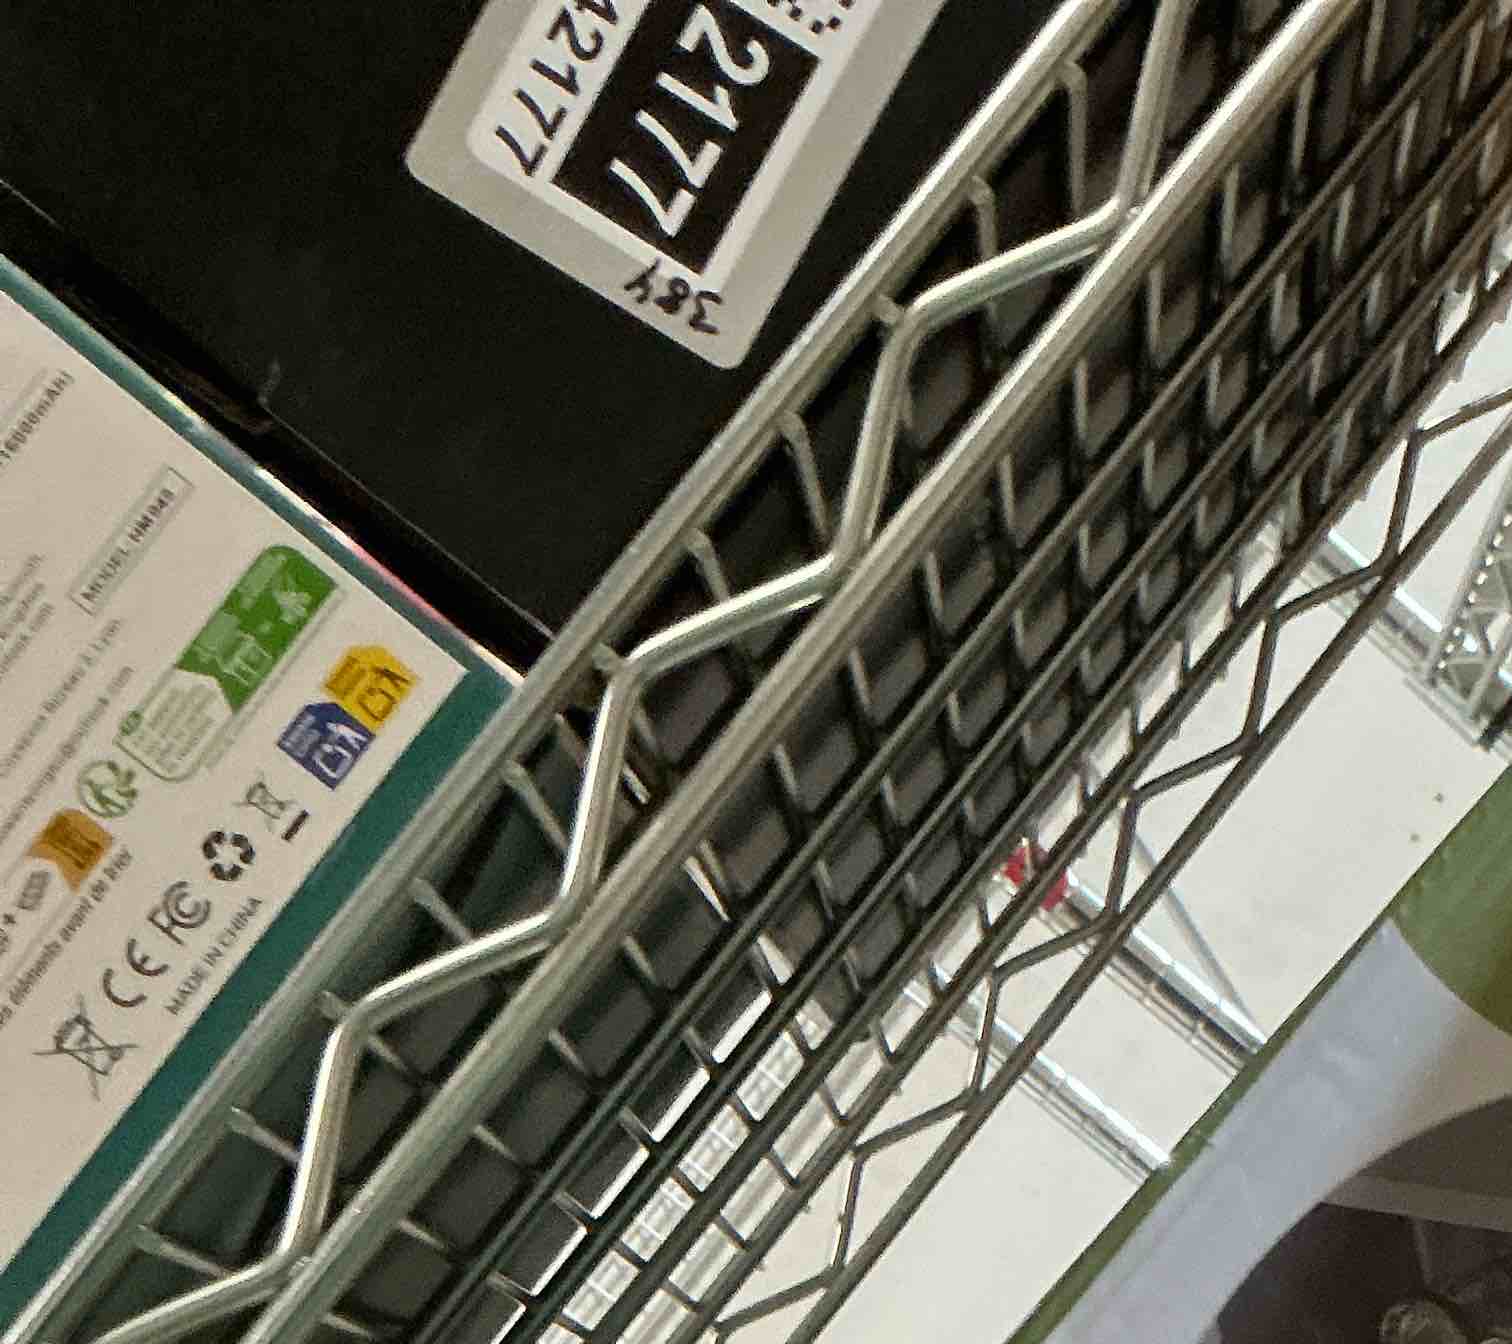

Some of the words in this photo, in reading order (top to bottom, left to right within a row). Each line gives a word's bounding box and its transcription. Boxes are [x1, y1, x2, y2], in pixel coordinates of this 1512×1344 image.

[609, 4, 771, 238] 2177
[162, 965, 210, 1017] MADE
[200, 944, 225, 969] IN
[217, 896, 264, 949] CHINA
